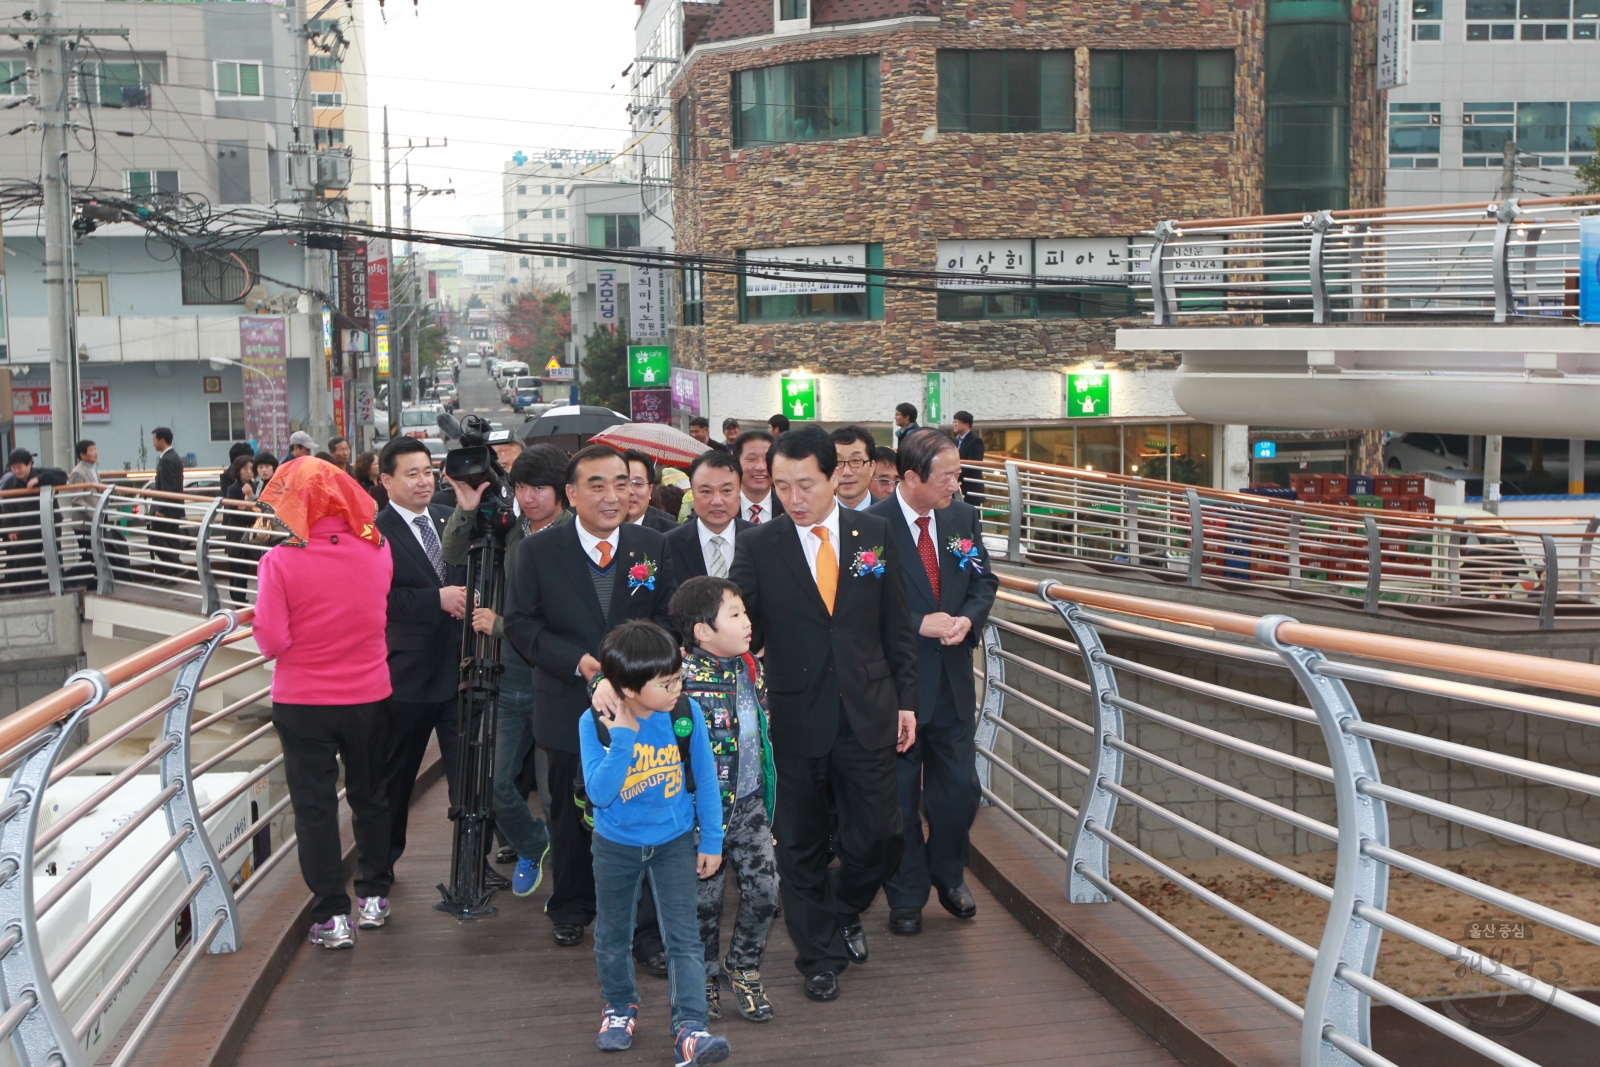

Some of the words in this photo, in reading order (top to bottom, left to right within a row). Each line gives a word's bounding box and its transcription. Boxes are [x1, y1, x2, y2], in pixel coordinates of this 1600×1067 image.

[948, 249, 1023, 274] 이상희
[1045, 250, 1120, 266] 피아노
[368, 263, 387, 275] BHC
[599, 273, 615, 318] 굿모닝
[638, 322, 655, 330] 학원
[1260, 449, 1271, 457] 49
[620, 781, 648, 803] JUMP
[648, 773, 665, 787] UP
